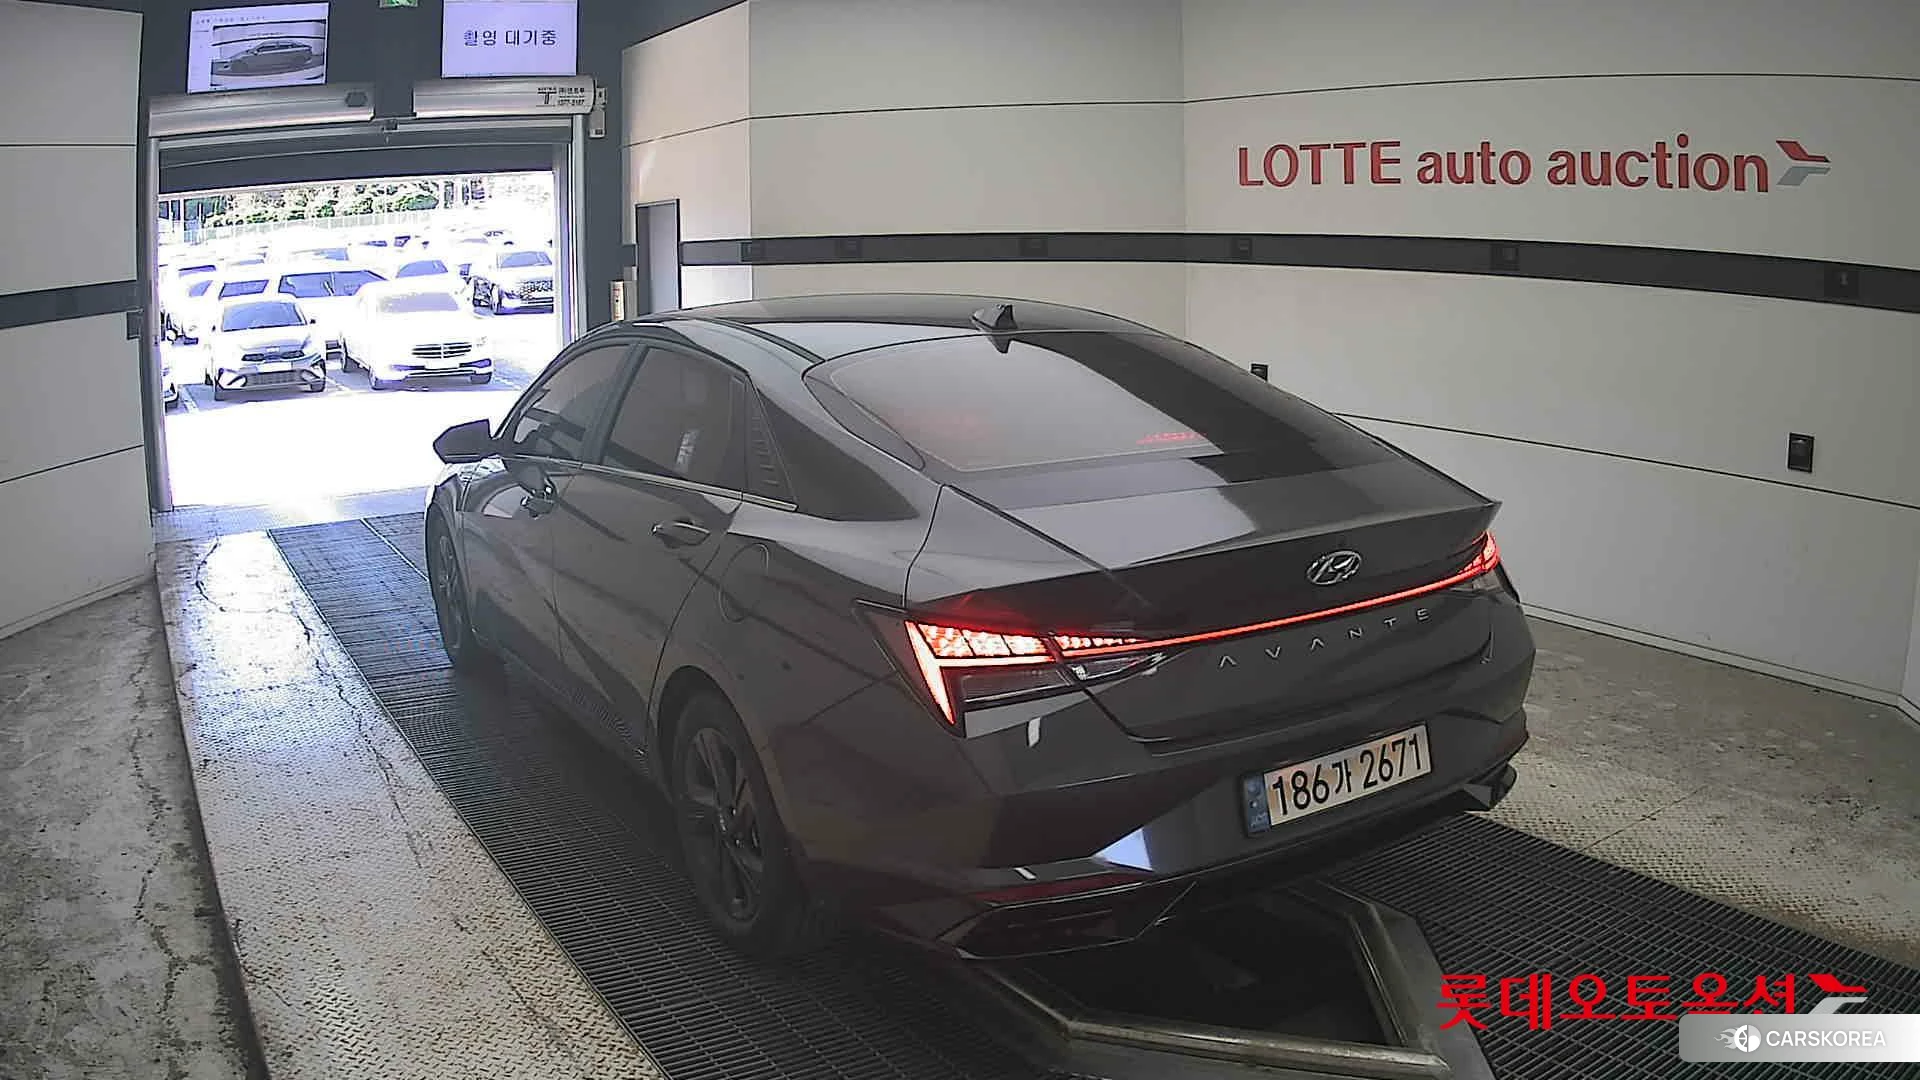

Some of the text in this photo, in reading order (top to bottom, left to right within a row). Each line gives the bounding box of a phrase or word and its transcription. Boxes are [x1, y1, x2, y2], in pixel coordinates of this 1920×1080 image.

[505, 29, 557, 47] 대기중
[1238, 133, 1769, 193] LOTTE auto auction
[1218, 608, 1430, 669] AVANTE
[1272, 733, 1422, 816] 186가 2671
